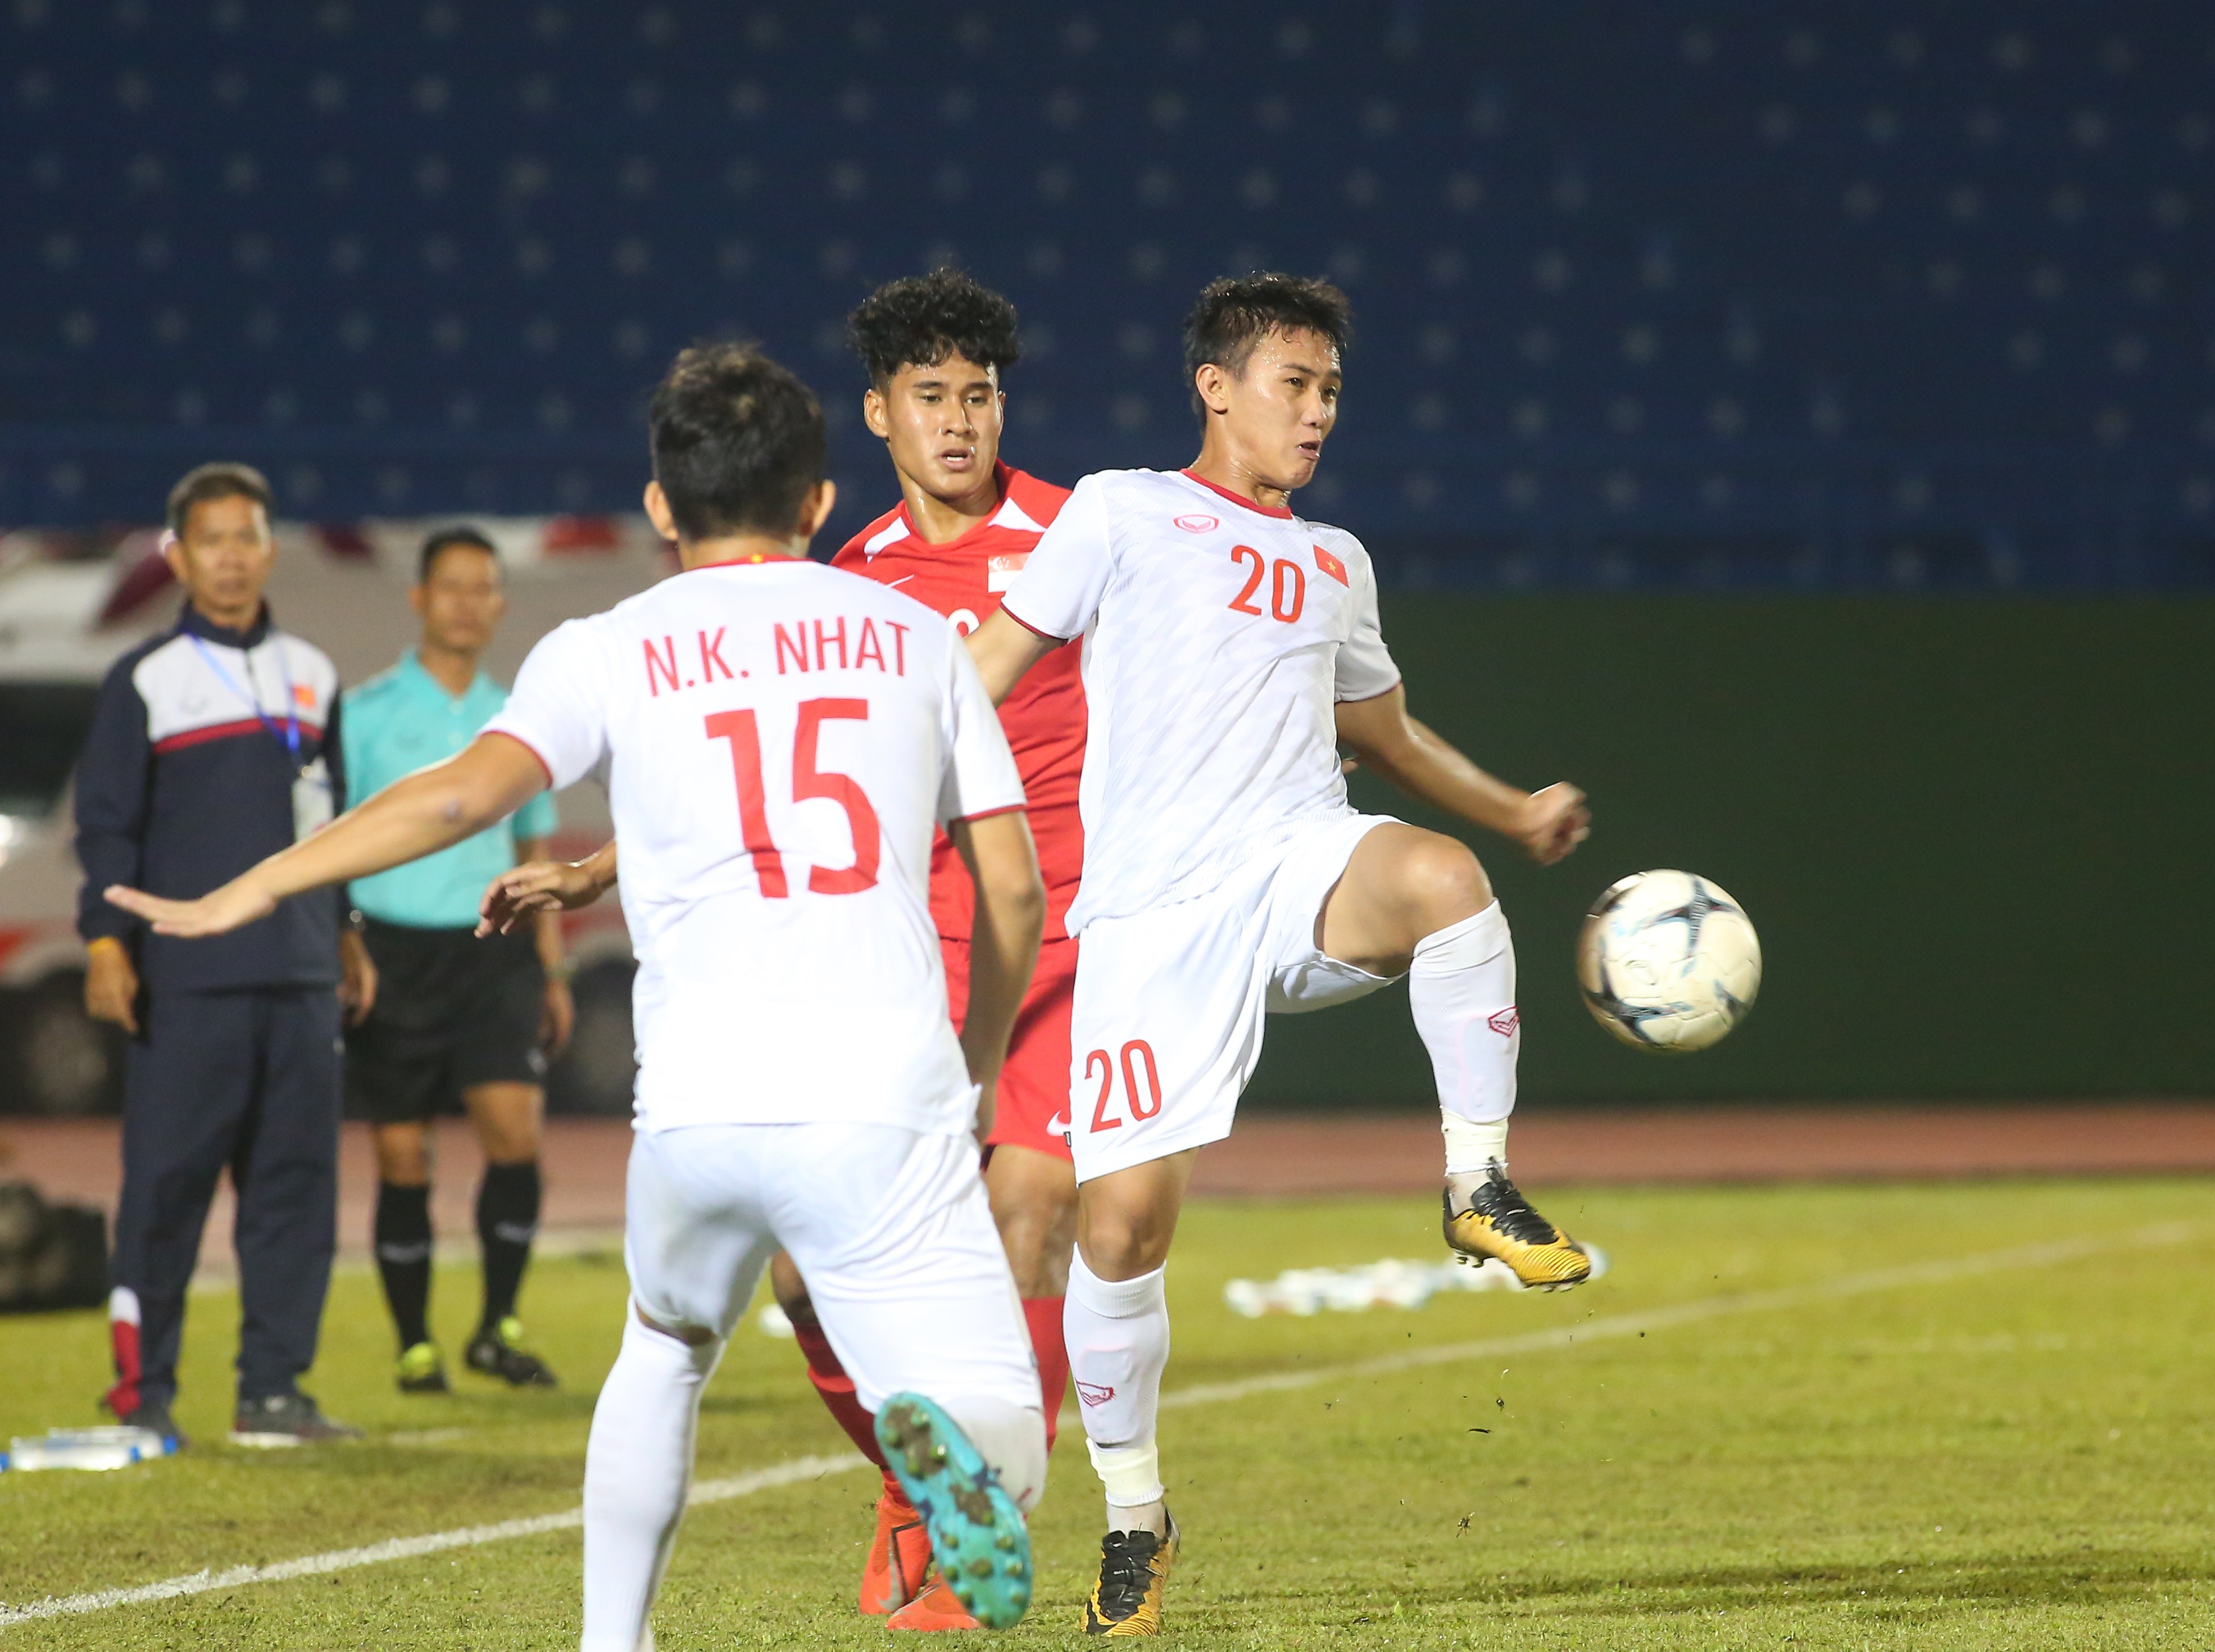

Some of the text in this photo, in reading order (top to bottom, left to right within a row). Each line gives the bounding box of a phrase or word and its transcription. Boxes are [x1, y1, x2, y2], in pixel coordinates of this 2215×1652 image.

[1228, 544, 1306, 624] 20
[642, 626, 749, 697] N.K.
[773, 615, 910, 677] NHAT
[704, 696, 881, 899] 15
[1084, 1039, 1162, 1133] 20
